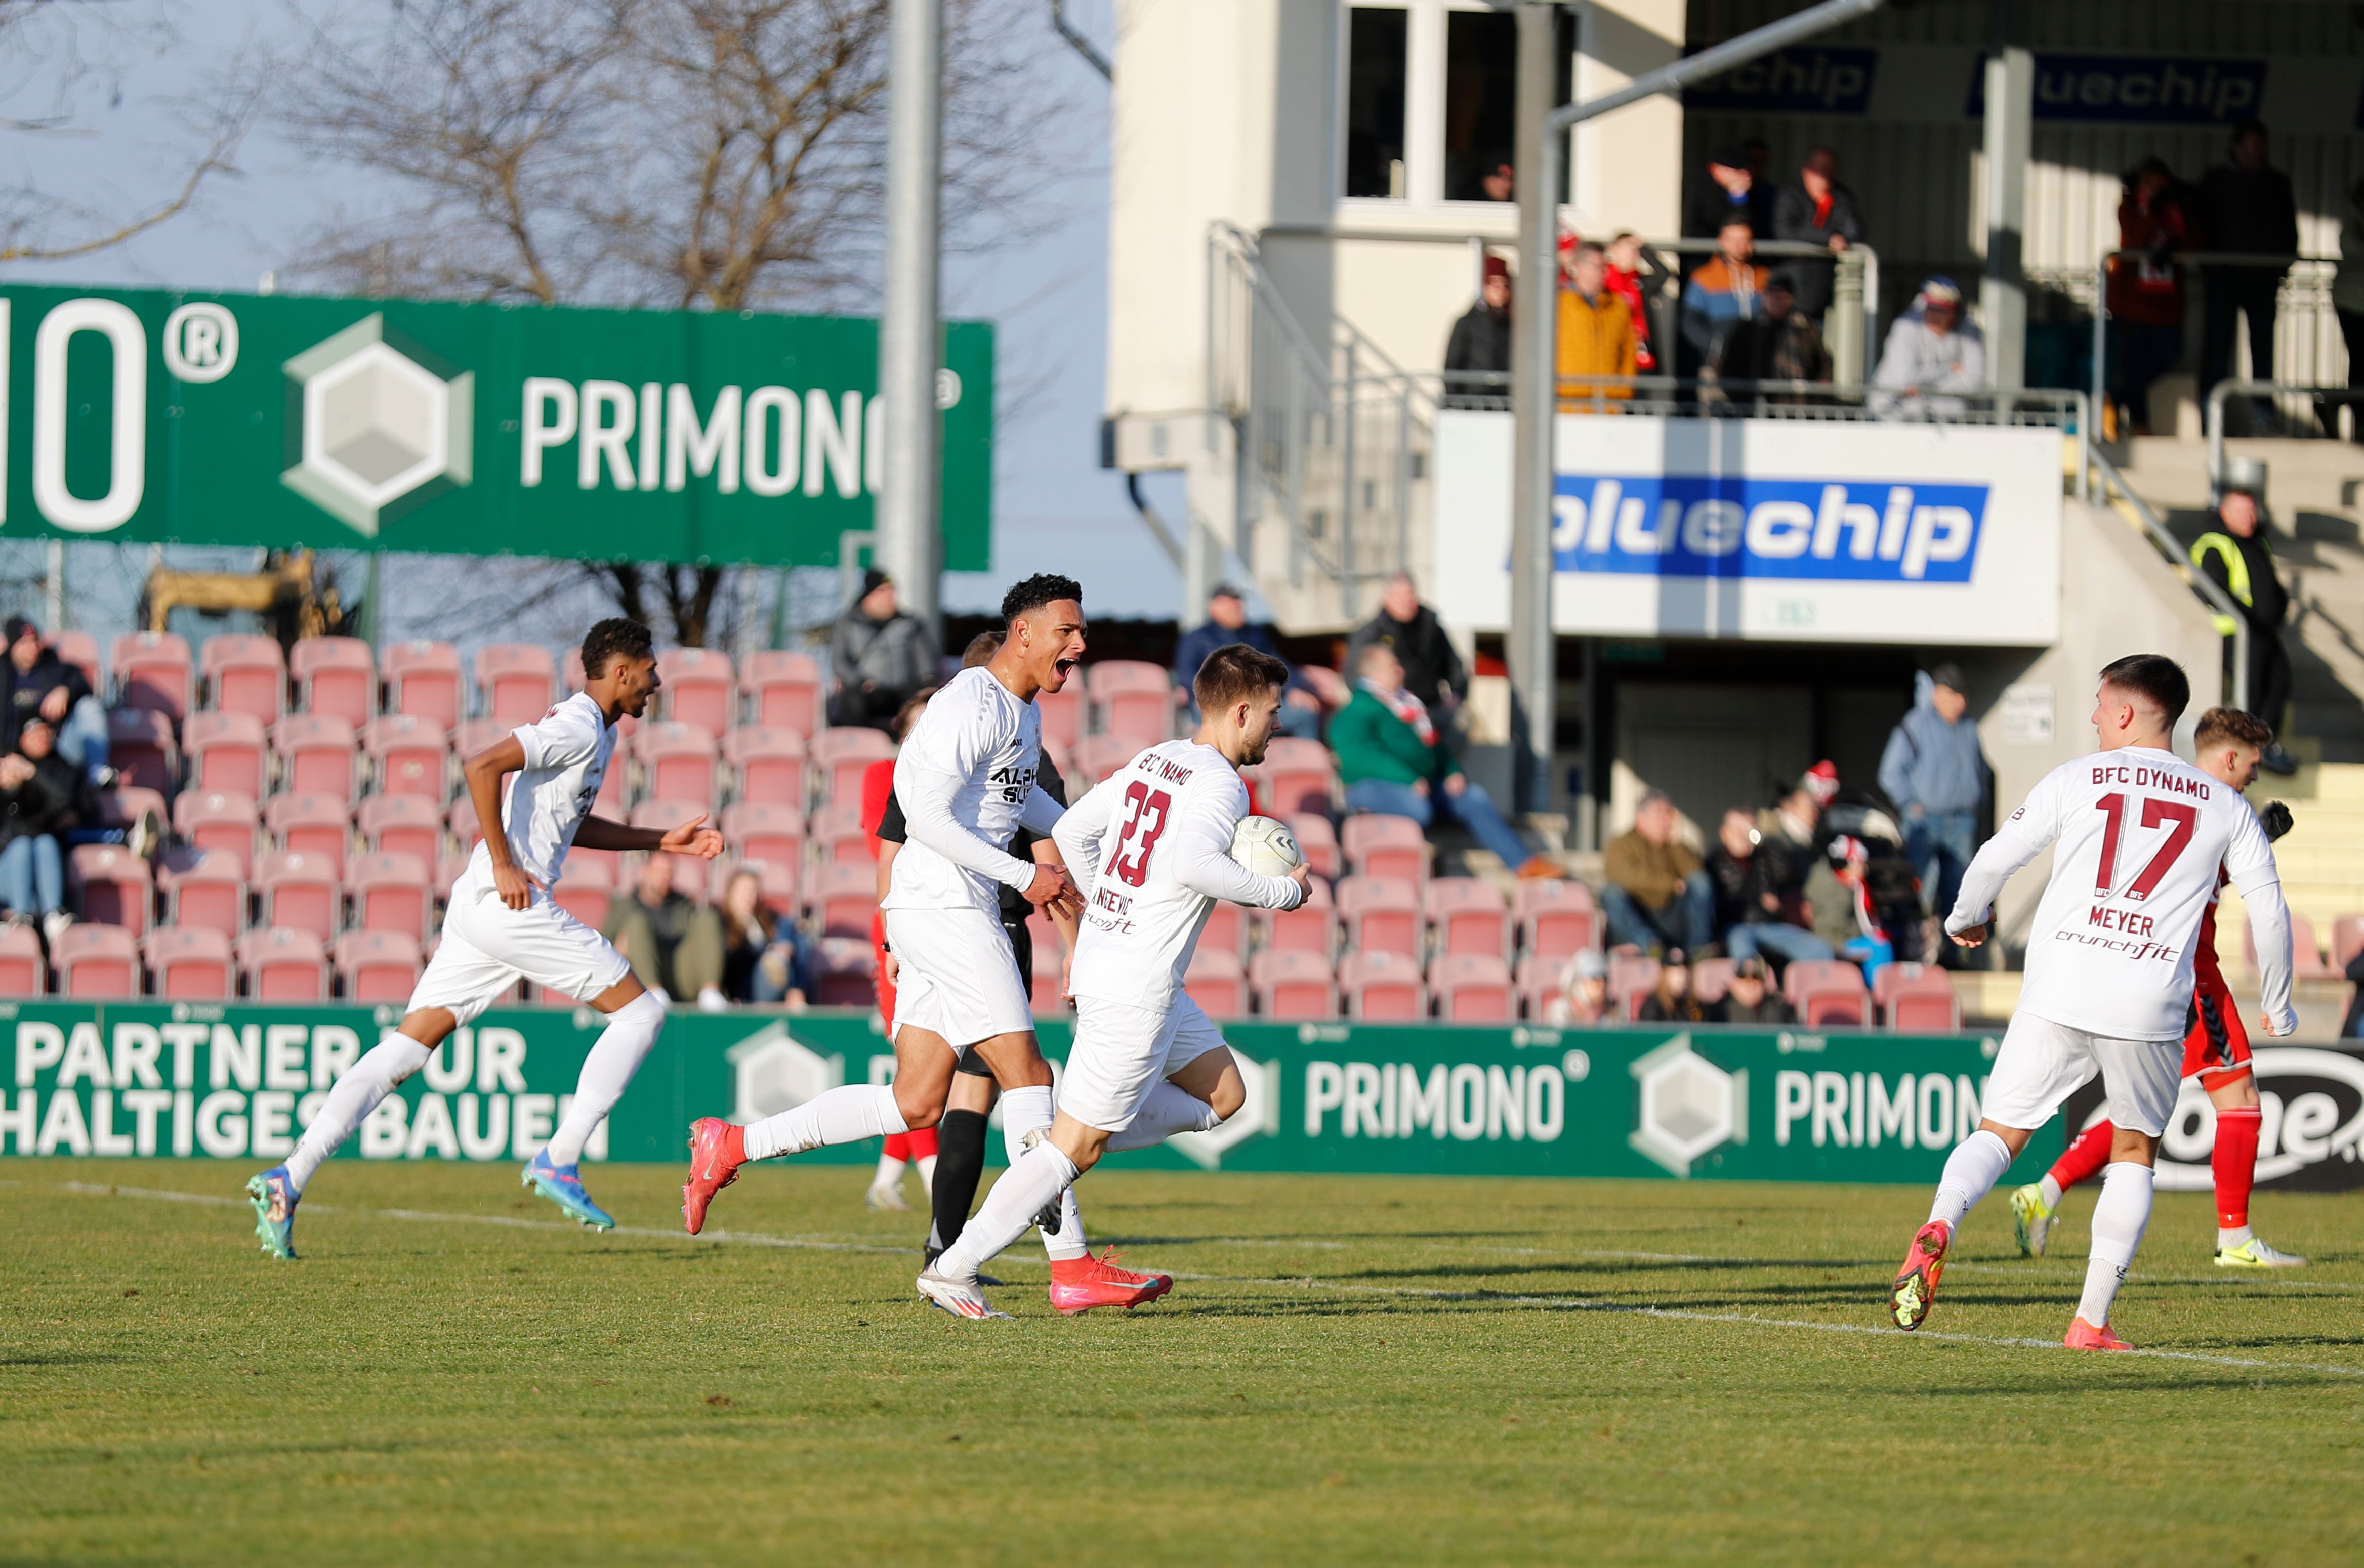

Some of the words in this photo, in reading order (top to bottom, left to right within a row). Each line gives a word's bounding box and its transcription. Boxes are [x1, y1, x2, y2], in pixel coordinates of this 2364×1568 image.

[2031, 61, 2255, 119] uechip
[1156, 758, 1193, 786] YNAMO
[2092, 766, 2130, 785] BFC
[2136, 767, 2210, 801] DYNAMO
[1003, 787, 1030, 805] SU
[1104, 780, 1172, 888] 23
[2094, 792, 2201, 901] 17
[2096, 887, 2109, 896] BFC
[2129, 889, 2144, 900] BFC
[2088, 905, 2154, 938] MEYER
[2055, 931, 2180, 962] crunchfit
[14, 1020, 361, 1091] PARTNER
[1774, 1069, 1990, 1150] PRIMON
